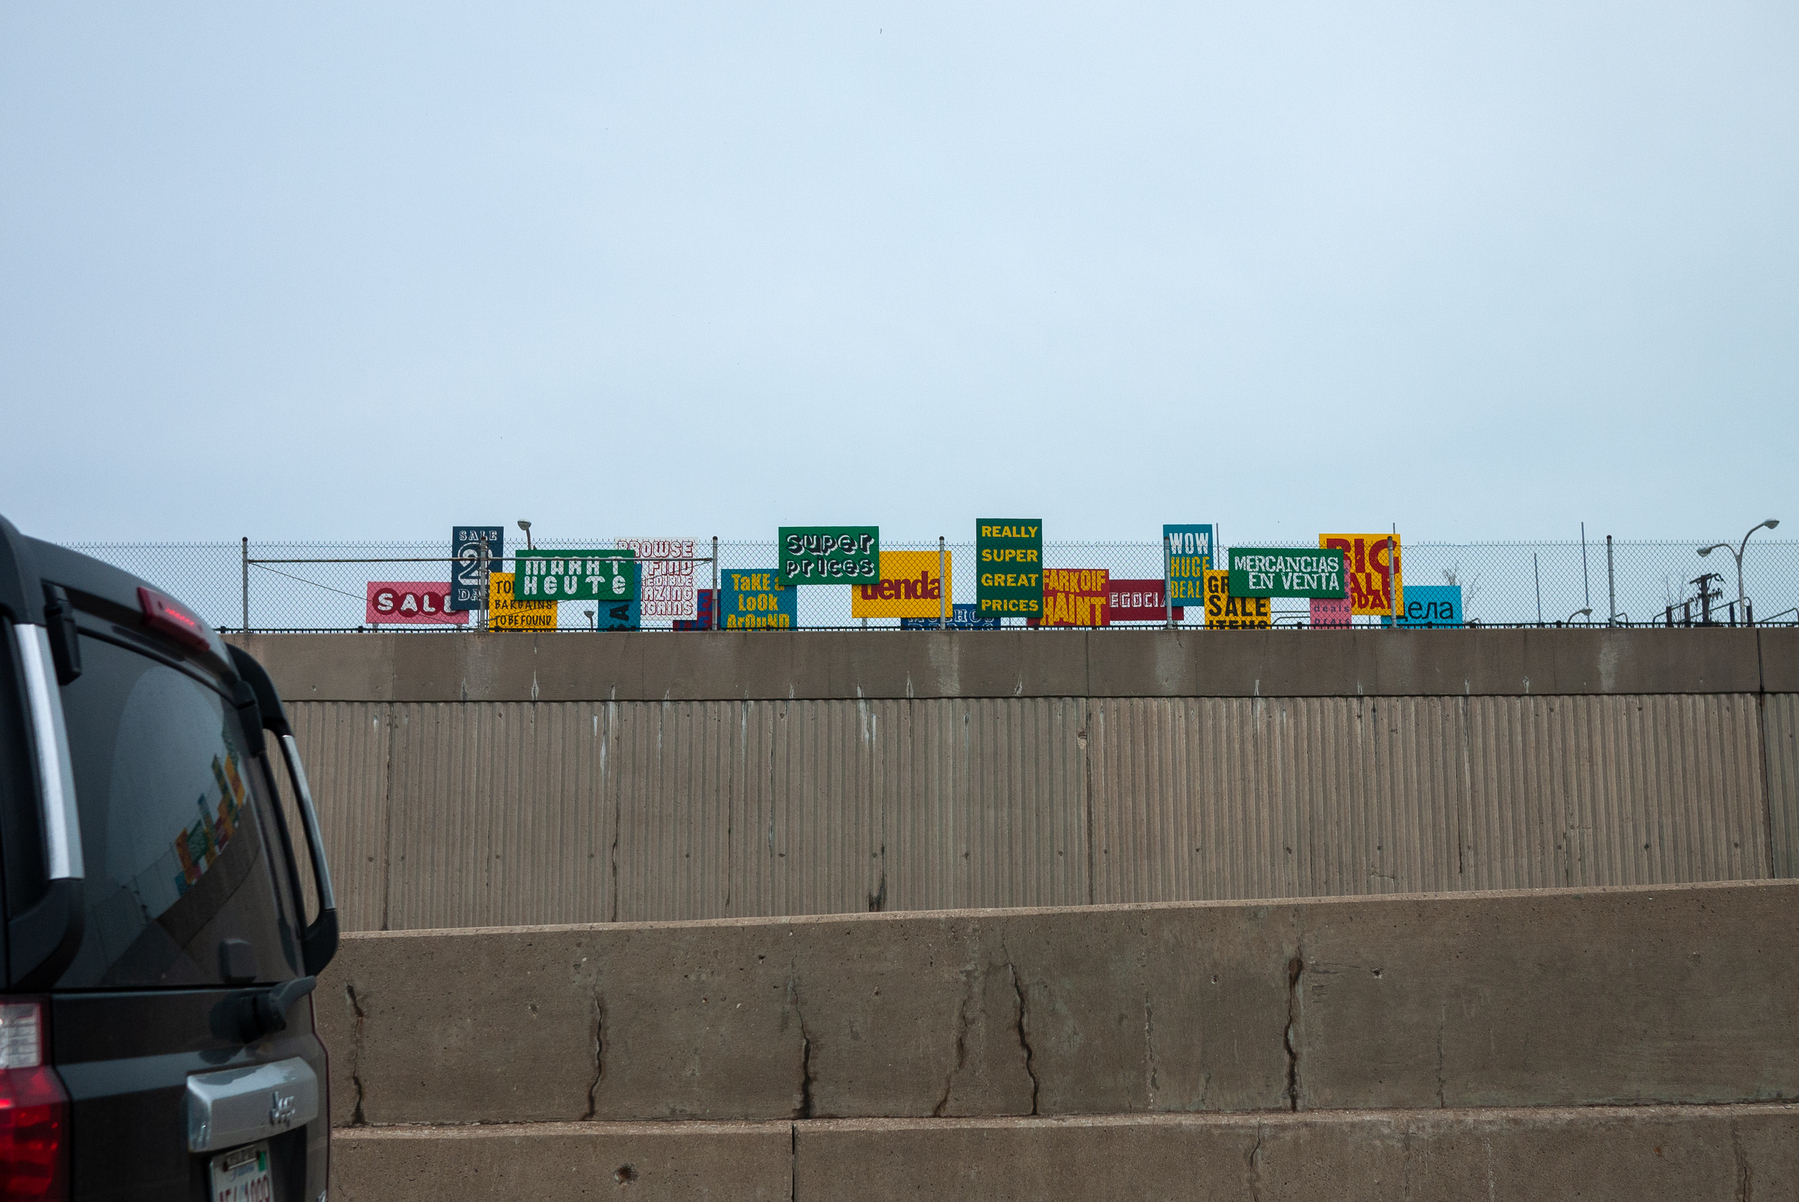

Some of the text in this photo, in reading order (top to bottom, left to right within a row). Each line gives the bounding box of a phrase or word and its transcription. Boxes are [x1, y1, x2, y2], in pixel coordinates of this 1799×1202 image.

[459, 530, 498, 541] SALE
[981, 525, 1038, 538] REALLY
[1169, 532, 1209, 555] WOW
[981, 549, 1038, 563] SUPER
[648, 558, 693, 576] FIND
[1170, 556, 1210, 578] HUGE
[1235, 555, 1339, 573] MERCANCIAS
[523, 575, 626, 595] HEUTE
[641, 576, 693, 587] EDIBLE
[981, 573, 1039, 587] GREAT
[1248, 572, 1274, 590] EN
[1281, 571, 1340, 591] VENTA
[641, 586, 693, 602] AZING
[1109, 592, 1165, 608] EGOCI
[495, 600, 552, 610] BARGAINS
[981, 599, 1039, 612] PRICES
[1208, 594, 1268, 617] SALE
[1313, 603, 1350, 613] deals
[495, 615, 552, 626] TO BE FOUND
